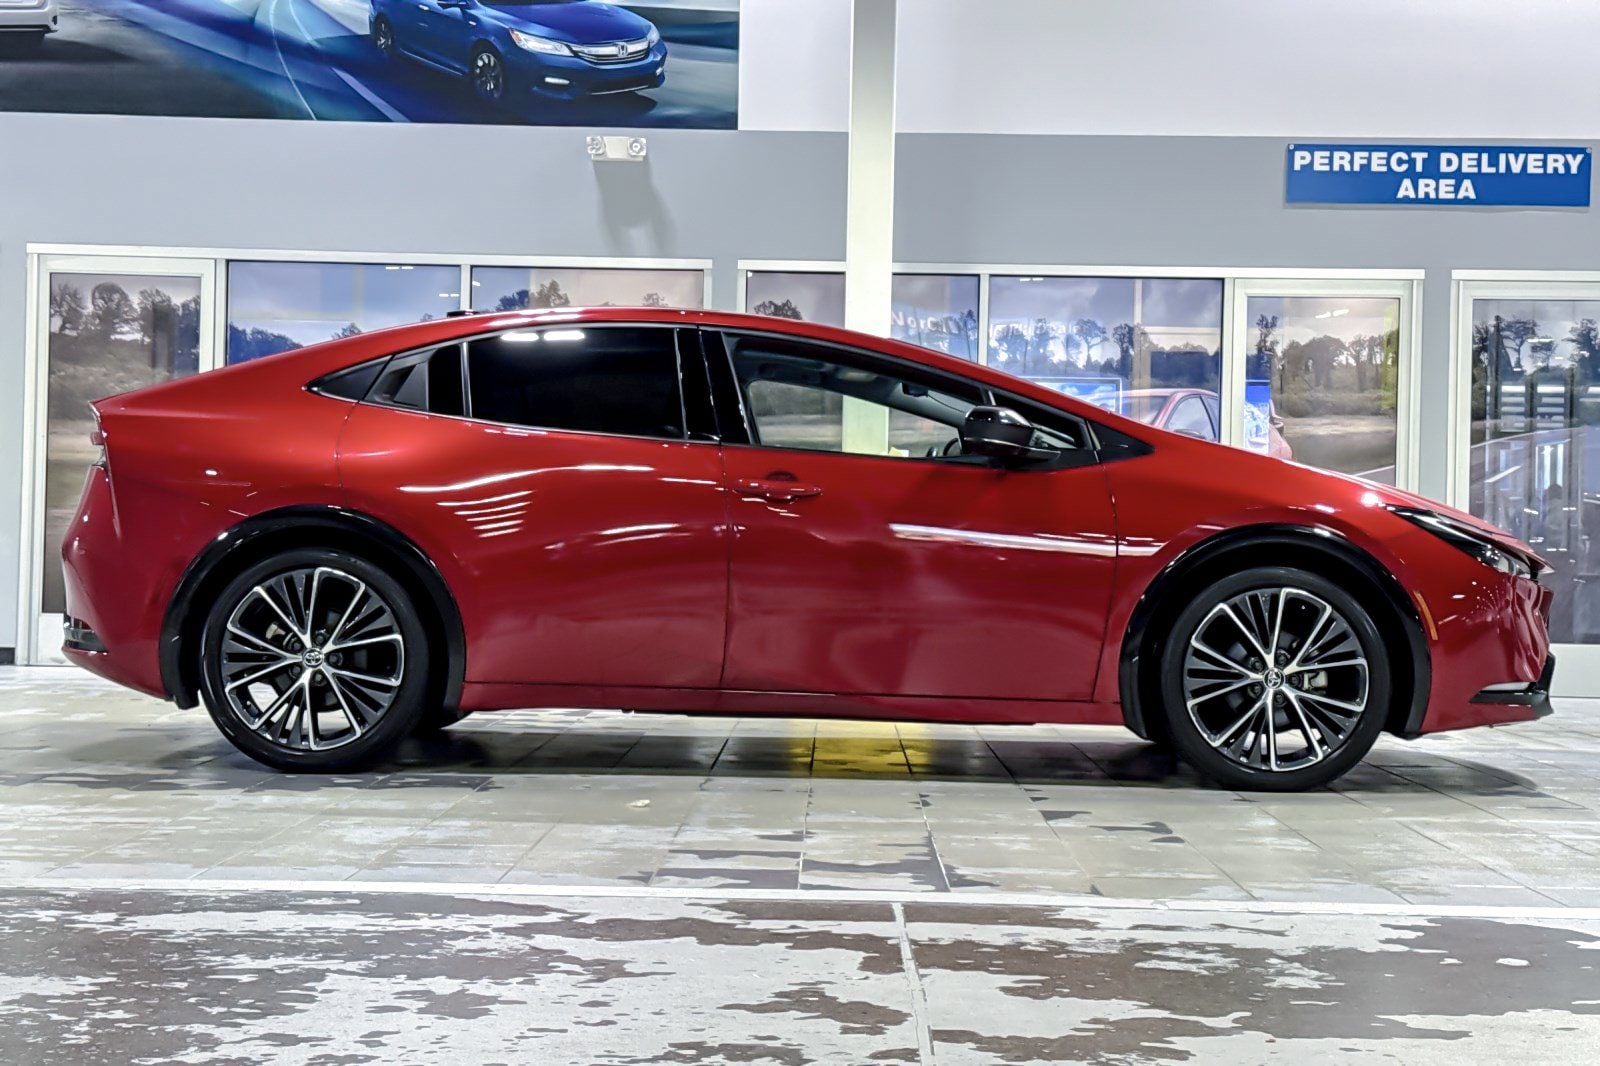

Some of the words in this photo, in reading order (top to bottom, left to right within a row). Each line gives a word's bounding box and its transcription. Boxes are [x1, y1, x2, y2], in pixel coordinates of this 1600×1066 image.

[1293, 151, 1428, 173] PERFECT
[1439, 152, 1585, 174] DELIVERY
[1395, 178, 1477, 200] AREA
